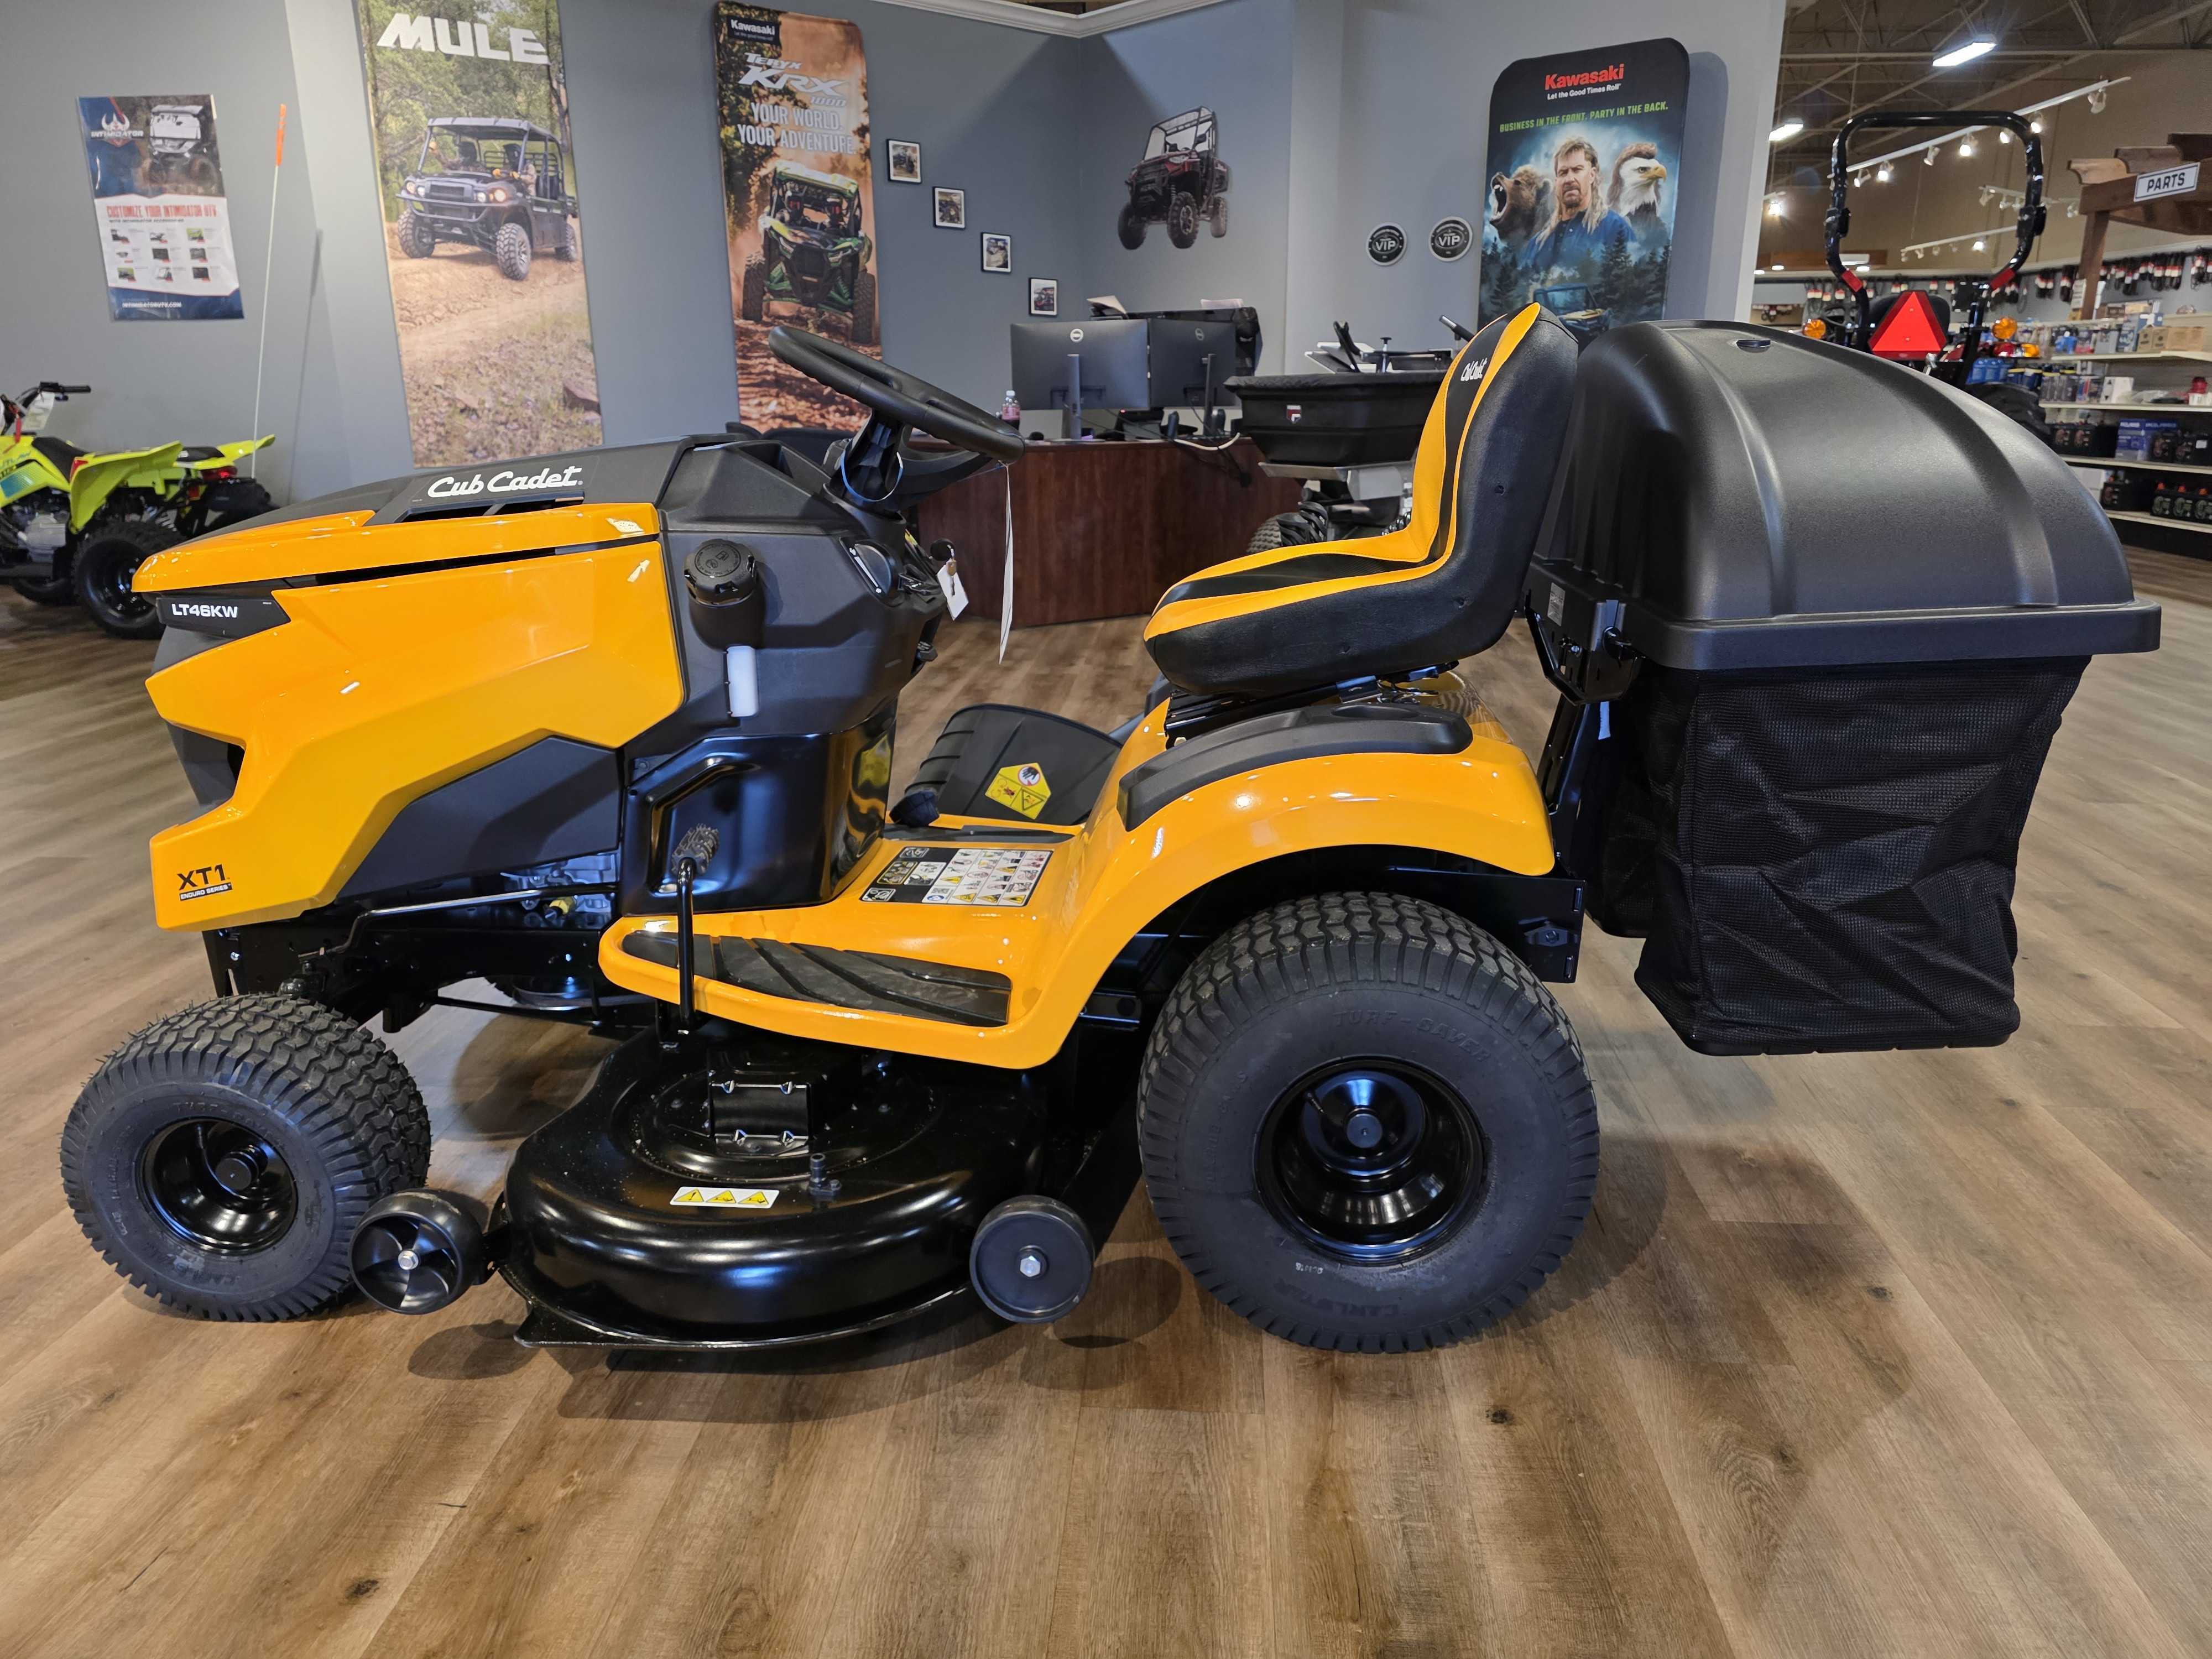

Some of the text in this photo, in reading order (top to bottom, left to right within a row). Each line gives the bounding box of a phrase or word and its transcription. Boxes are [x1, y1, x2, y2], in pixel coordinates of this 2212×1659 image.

[376, 13, 551, 65] MULE
[731, 19, 775, 36] Kawasaki
[738, 65, 848, 97] KRX
[1545, 63, 1625, 90] Kawasaki
[1569, 88, 1587, 97] Good
[1587, 86, 1605, 94] Times
[750, 102, 844, 131] YOUR WORLD.
[1499, 101, 1668, 133] BUSINESS IN THE FRONT. PARTY IN THE BACK.
[737, 124, 857, 154] YOUR ADVENTURE.
[2147, 172, 2185, 192] PARTS
[1375, 240, 1396, 251] VIP
[1438, 235, 1460, 246] VIP
[427, 466, 583, 498] Cub Cadet
[171, 603, 238, 618] LT46KW
[177, 864, 226, 891] XT1
[180, 884, 228, 900] ENDURO SERIES
